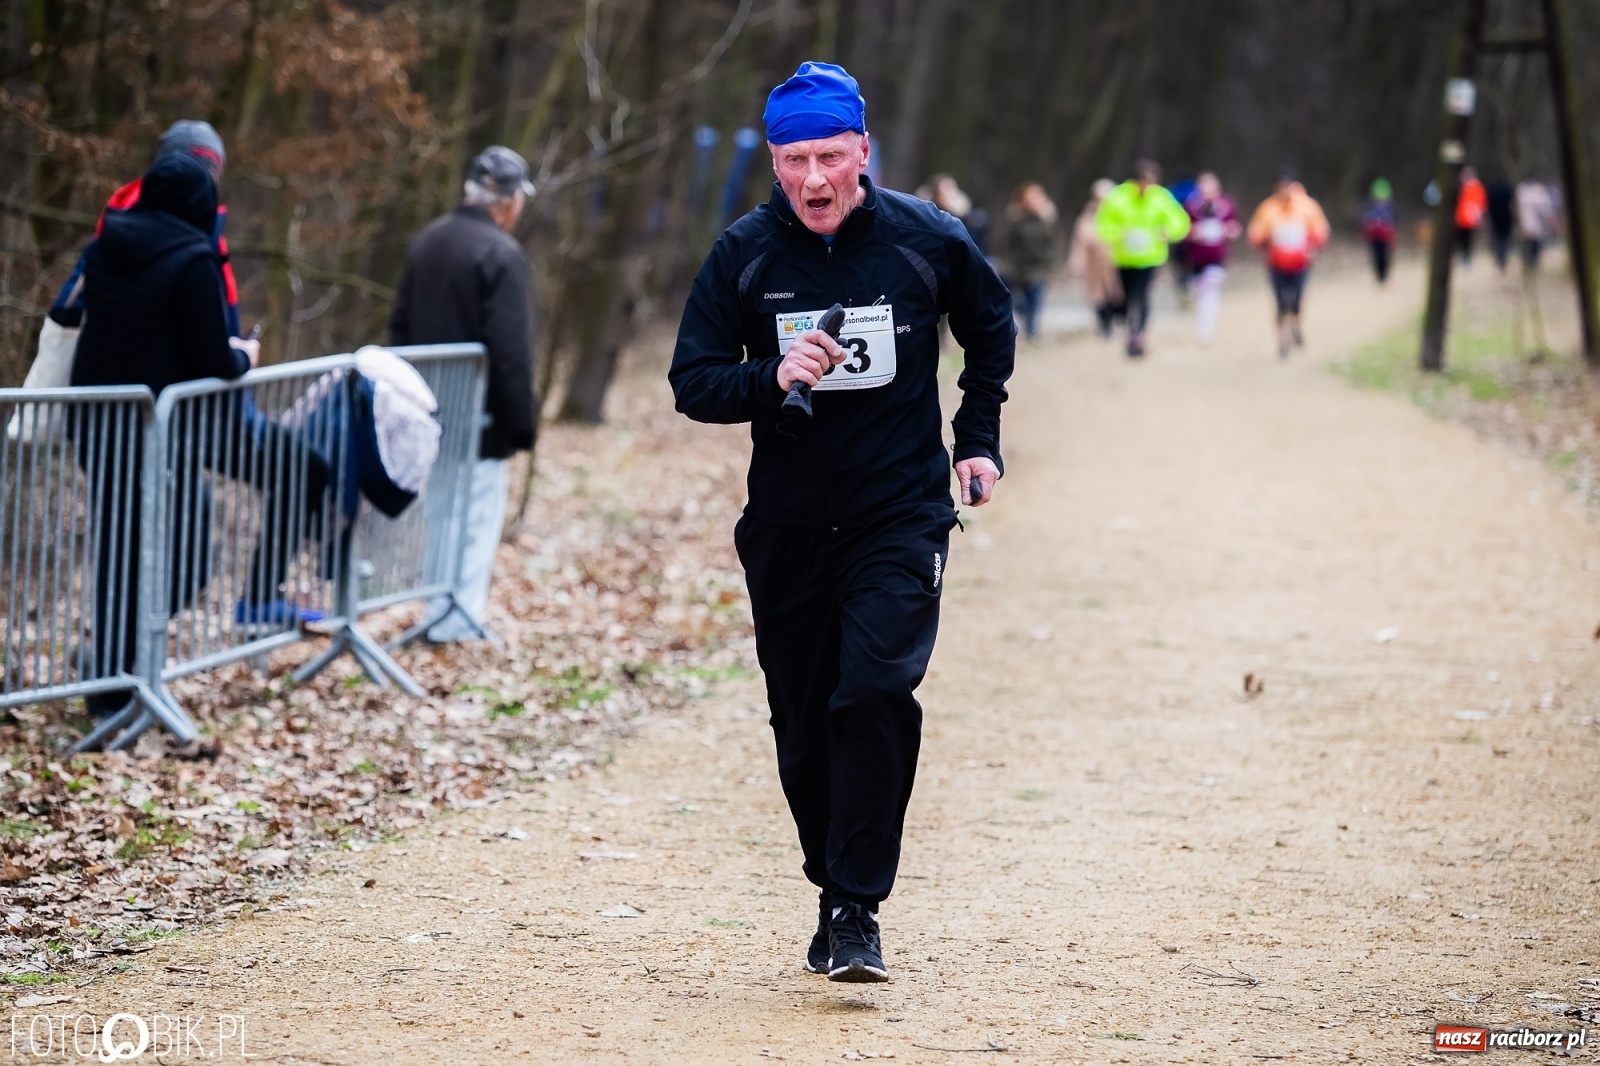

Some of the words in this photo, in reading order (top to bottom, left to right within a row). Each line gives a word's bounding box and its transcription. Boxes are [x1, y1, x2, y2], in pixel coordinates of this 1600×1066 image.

[763, 292, 795, 300] DOBSOM
[896, 324, 911, 334] BPS
[823, 337, 871, 376] 3
[933, 552, 942, 588] adidas
